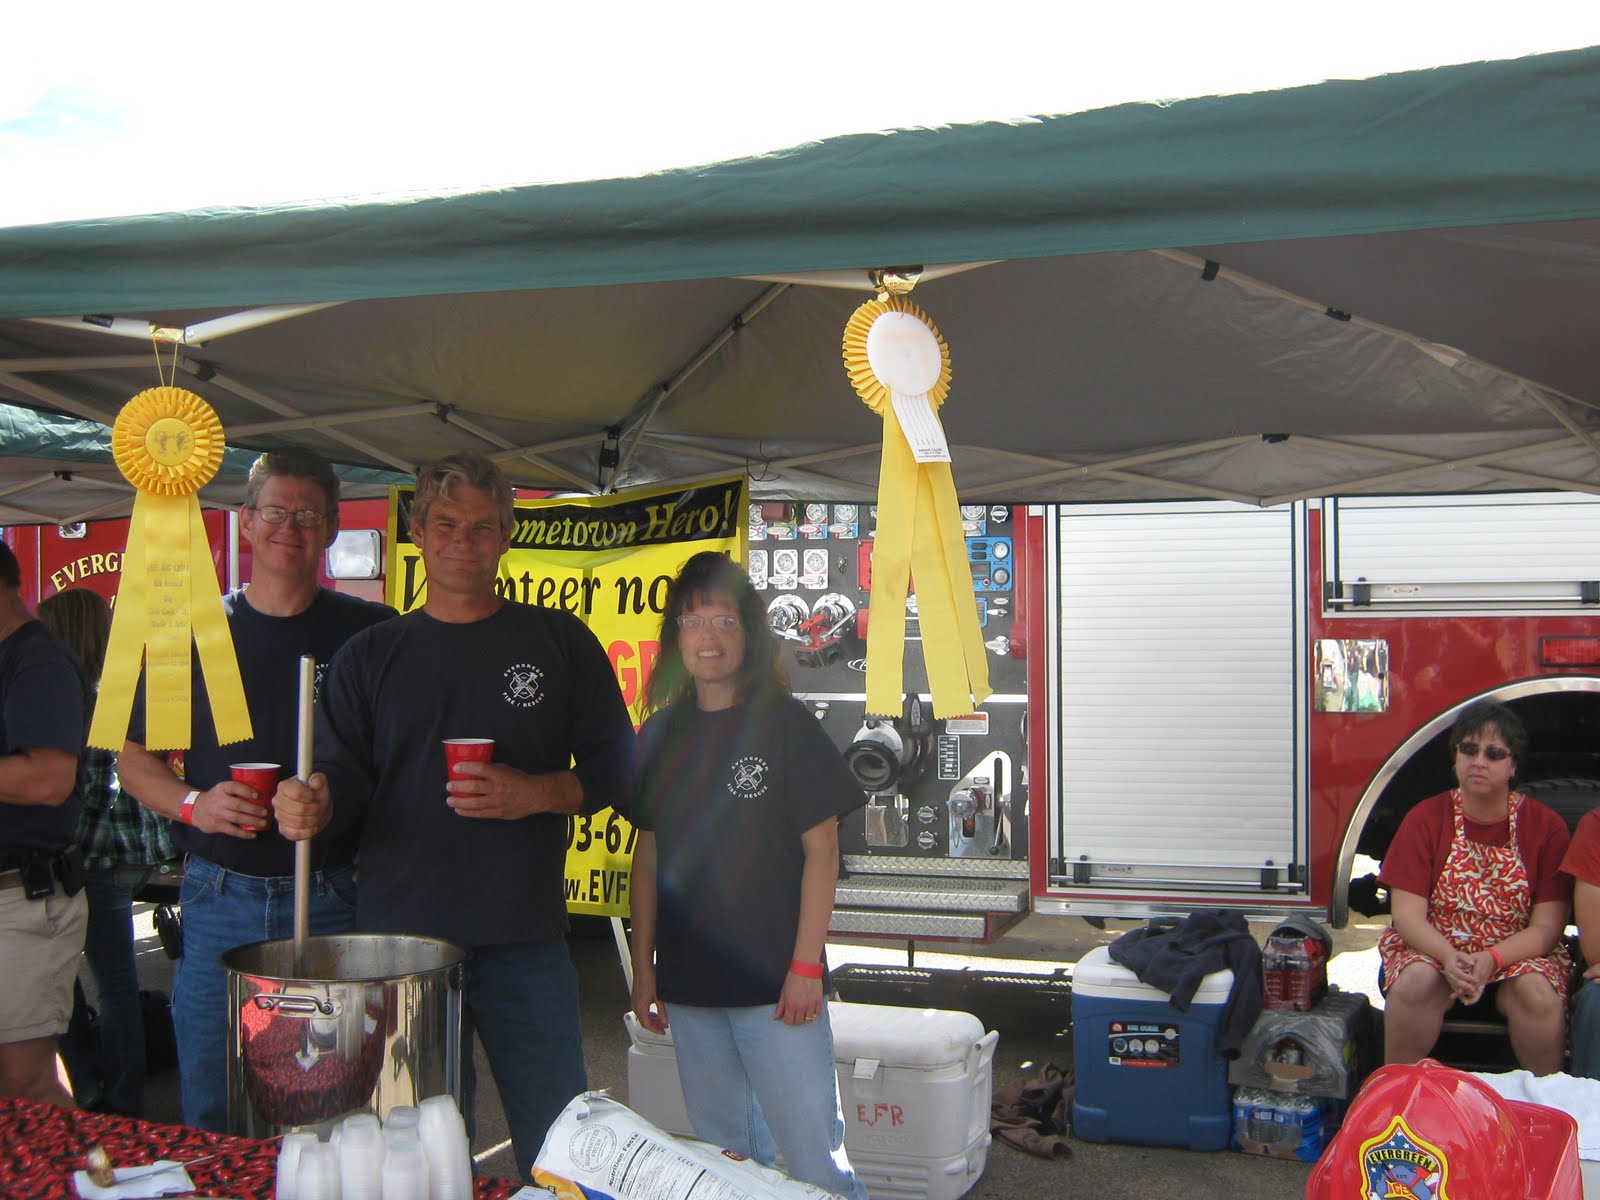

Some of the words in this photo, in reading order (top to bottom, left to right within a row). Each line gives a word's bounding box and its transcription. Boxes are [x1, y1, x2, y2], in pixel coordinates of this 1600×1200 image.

[511, 517, 636, 547] ometown
[640, 489, 732, 542] Hero!
[522, 692, 545, 708] RESCUE
[743, 785, 768, 799] RESCUE
[565, 868, 631, 905] w.EVF
[608, 1152, 625, 1187] Nutrition
[622, 1133, 639, 1152] Facts
[1369, 1149, 1432, 1169] EVERGREEN
